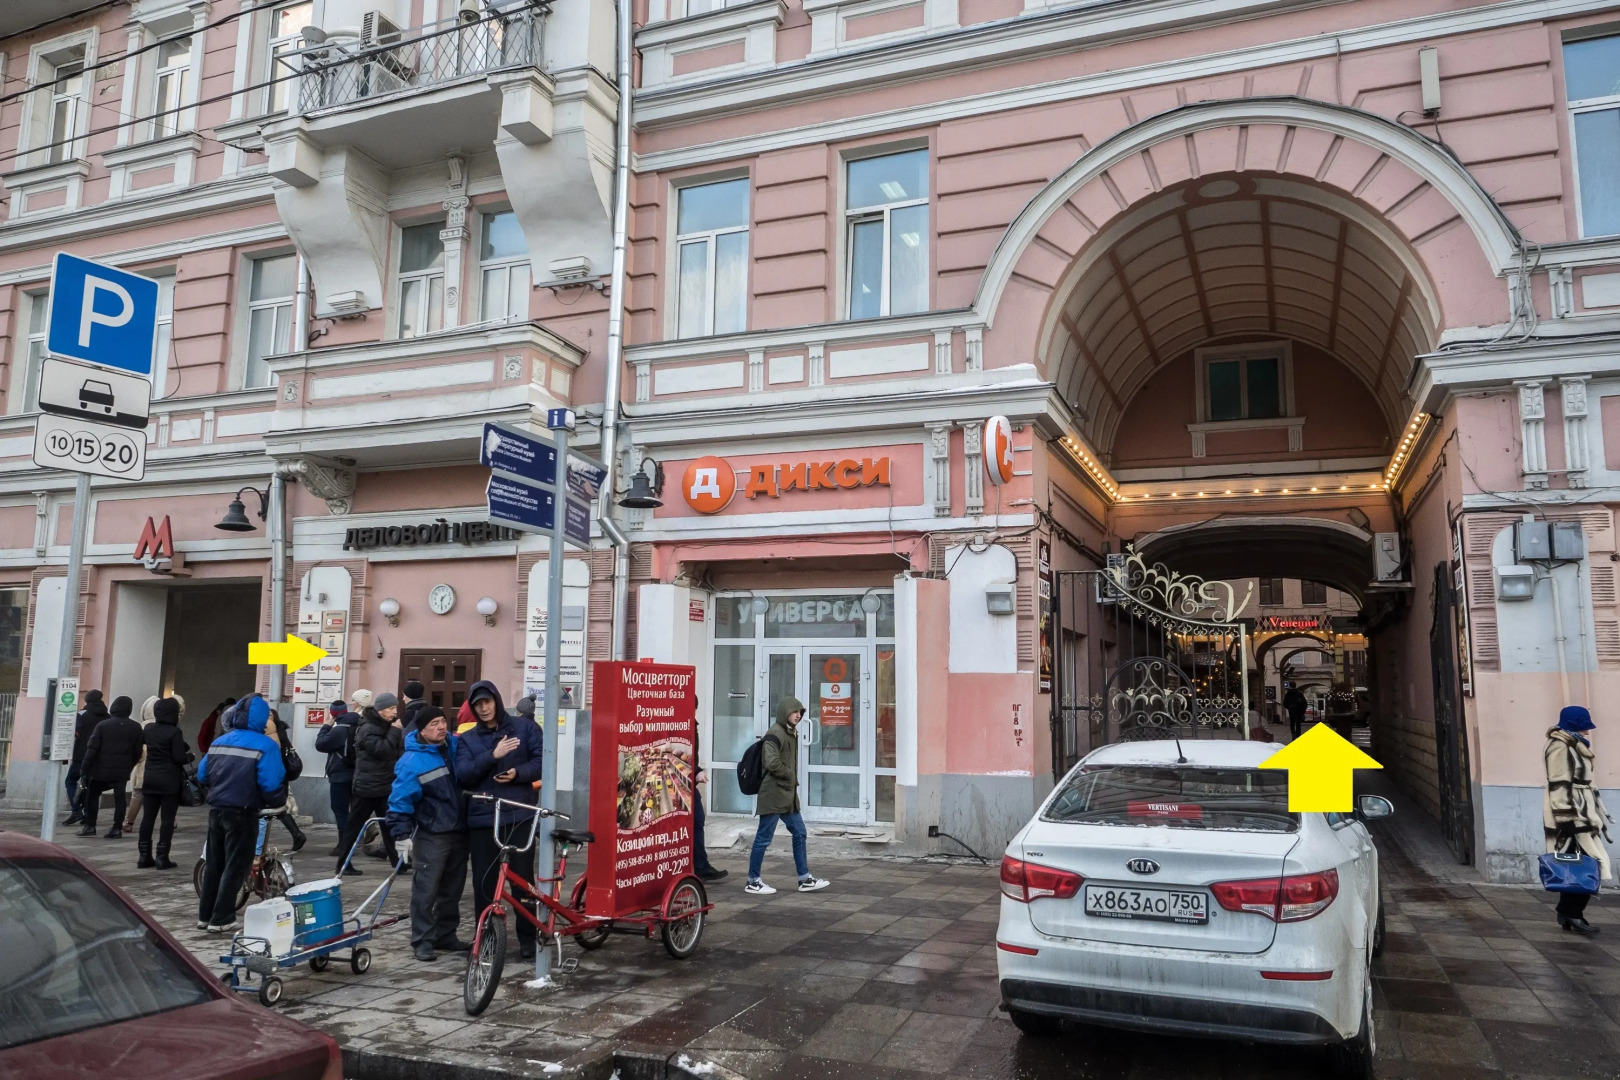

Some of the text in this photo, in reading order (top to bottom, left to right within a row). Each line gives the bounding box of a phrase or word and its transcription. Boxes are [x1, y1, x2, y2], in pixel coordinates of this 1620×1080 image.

[78, 274, 134, 347] P
[51, 435, 132, 465] 10 15 20
[690, 457, 891, 499] Д ДИКСИ
[343, 518, 449, 550] ДЕЛОВОЙ
[737, 600, 886, 624] УИВЕРСА
[622, 667, 691, 689] Мосцветторг
[628, 687, 685, 700] Цветочная база
[636, 704, 675, 720] Разумный
[619, 719, 691, 735] выбор миллионов!
[1148, 803, 1178, 811] VERTISANI
[616, 833, 654, 853] Козицкий
[1131, 861, 1154, 872] KIA
[616, 877, 632, 889] Часы
[633, 872, 655, 887] работы
[1171, 893, 1200, 910] 750
